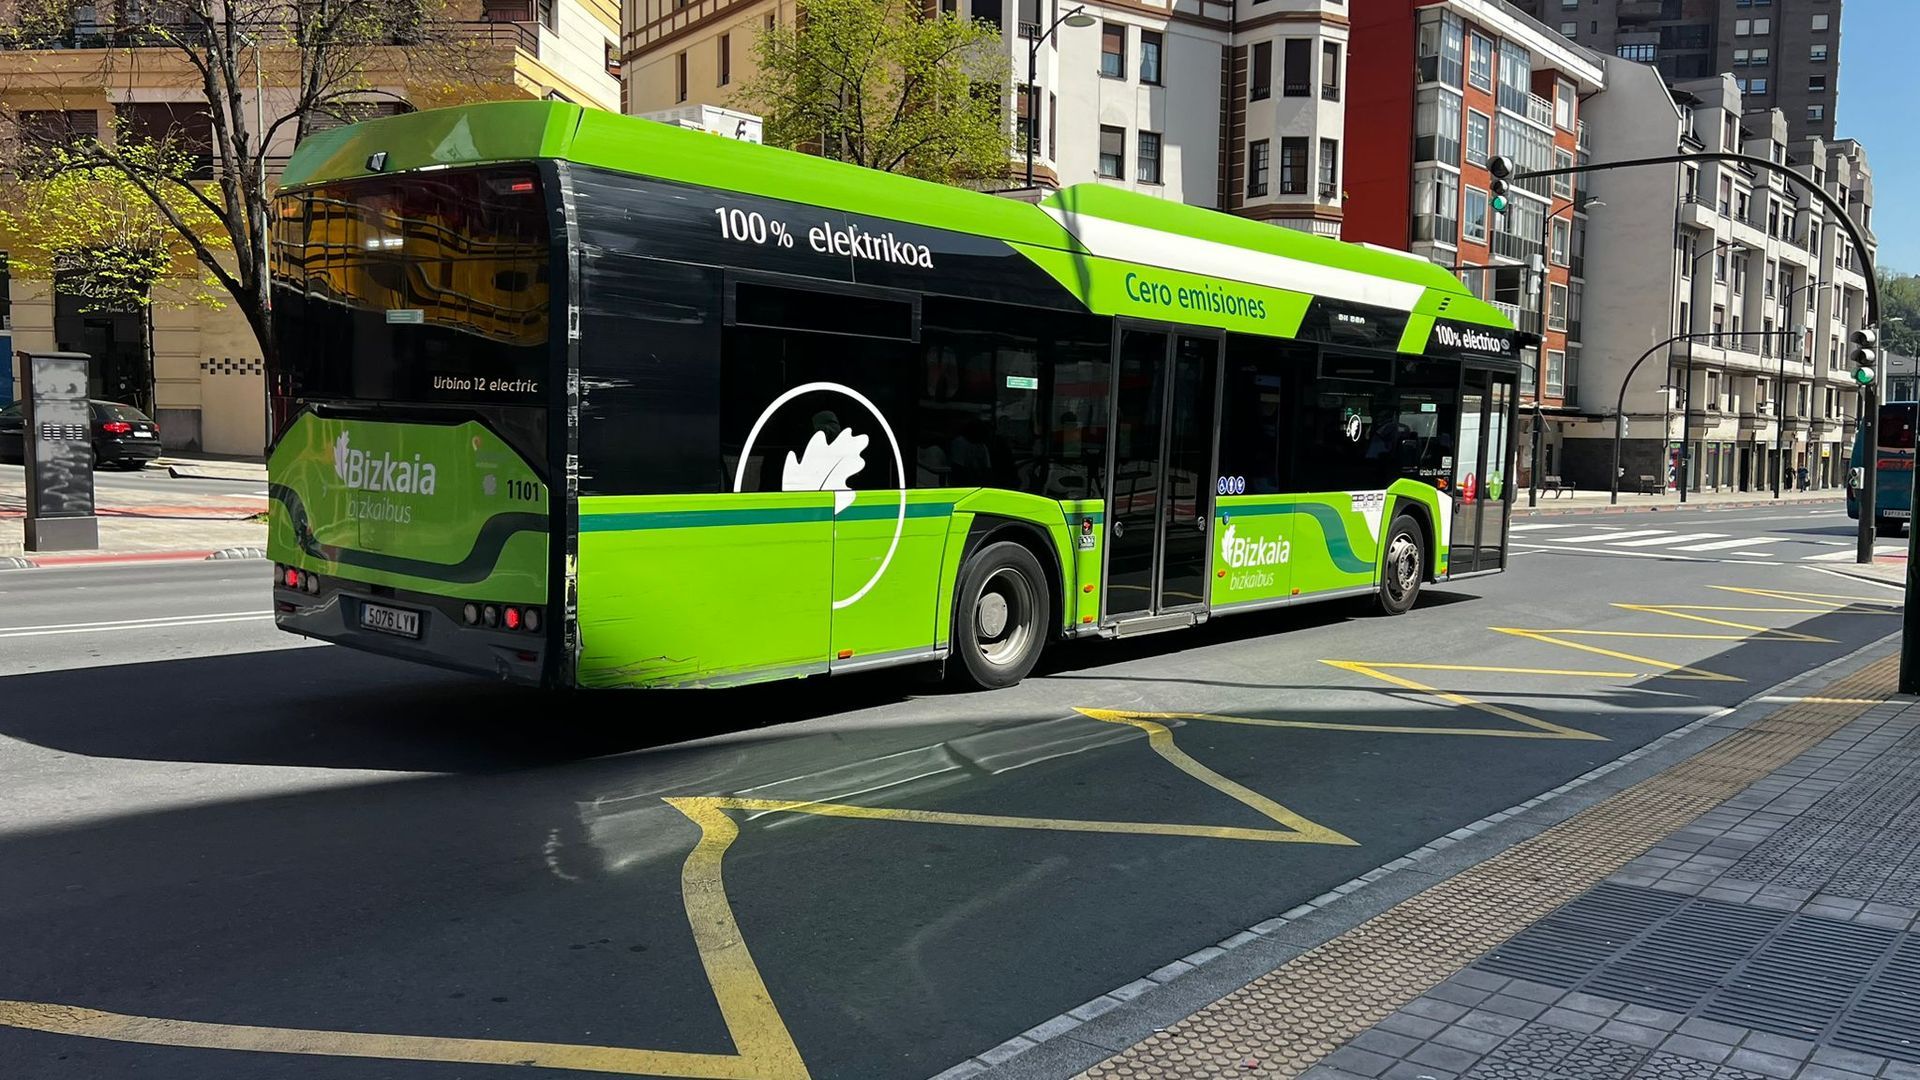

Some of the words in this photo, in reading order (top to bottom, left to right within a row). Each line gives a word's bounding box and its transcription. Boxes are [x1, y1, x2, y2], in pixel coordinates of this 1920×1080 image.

[808, 221, 934, 269] elektrikoa
[1125, 272, 1172, 306] Cero
[1178, 283, 1266, 319] emisiones
[1436, 325, 1461, 347] 100%
[1463, 329, 1500, 352] eléctrico
[433, 376, 471, 390] Urbino
[474, 377, 486, 391] 12
[489, 378, 539, 393] electric
[348, 449, 436, 495] Bizkaia
[506, 479, 540, 502] 1101
[347, 498, 412, 524] bizkaibus
[1231, 535, 1290, 568] Bizkaia
[1230, 570, 1274, 590] bizkaibus
[369, 607, 394, 627] 5076
